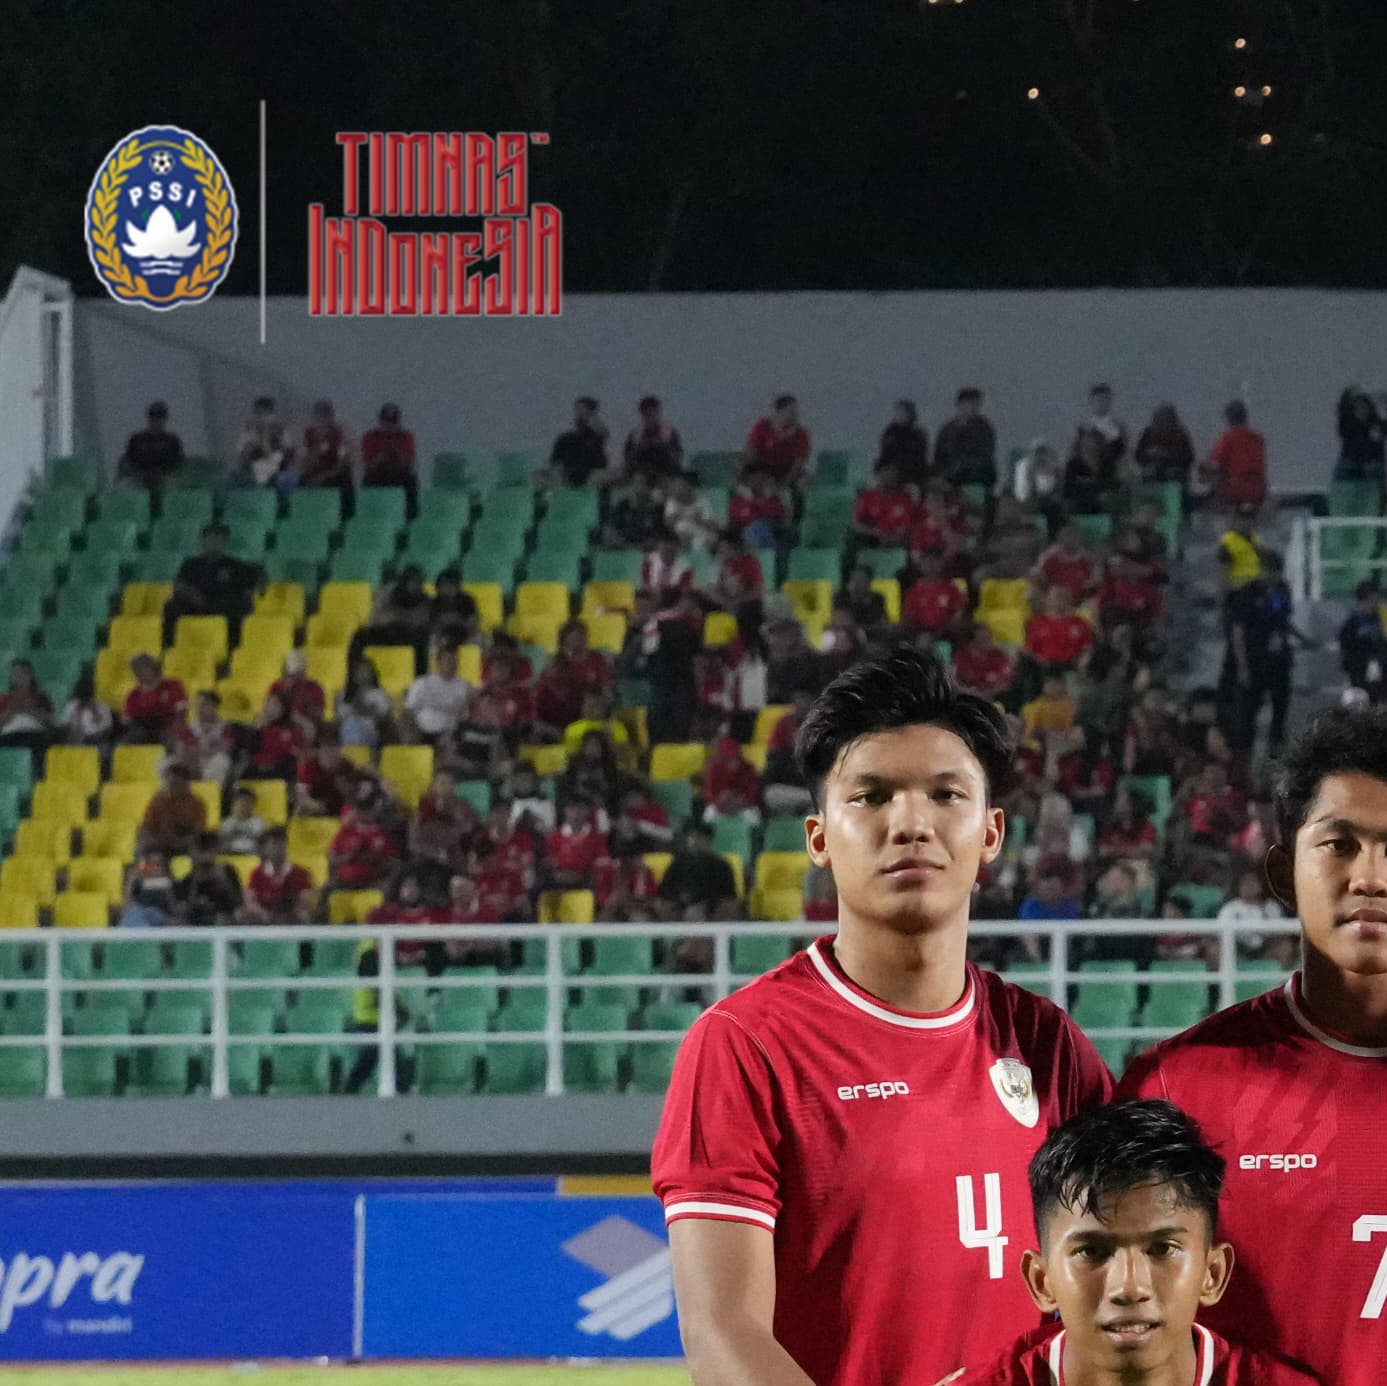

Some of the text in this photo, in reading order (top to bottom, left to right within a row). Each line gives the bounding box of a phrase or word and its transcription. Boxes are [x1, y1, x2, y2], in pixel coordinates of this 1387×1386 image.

[837, 1081, 909, 1100] erspo
[1239, 1153, 1317, 1173] erspo
[956, 1173, 1008, 1279] 4
[0, 1251, 145, 1333] pra
